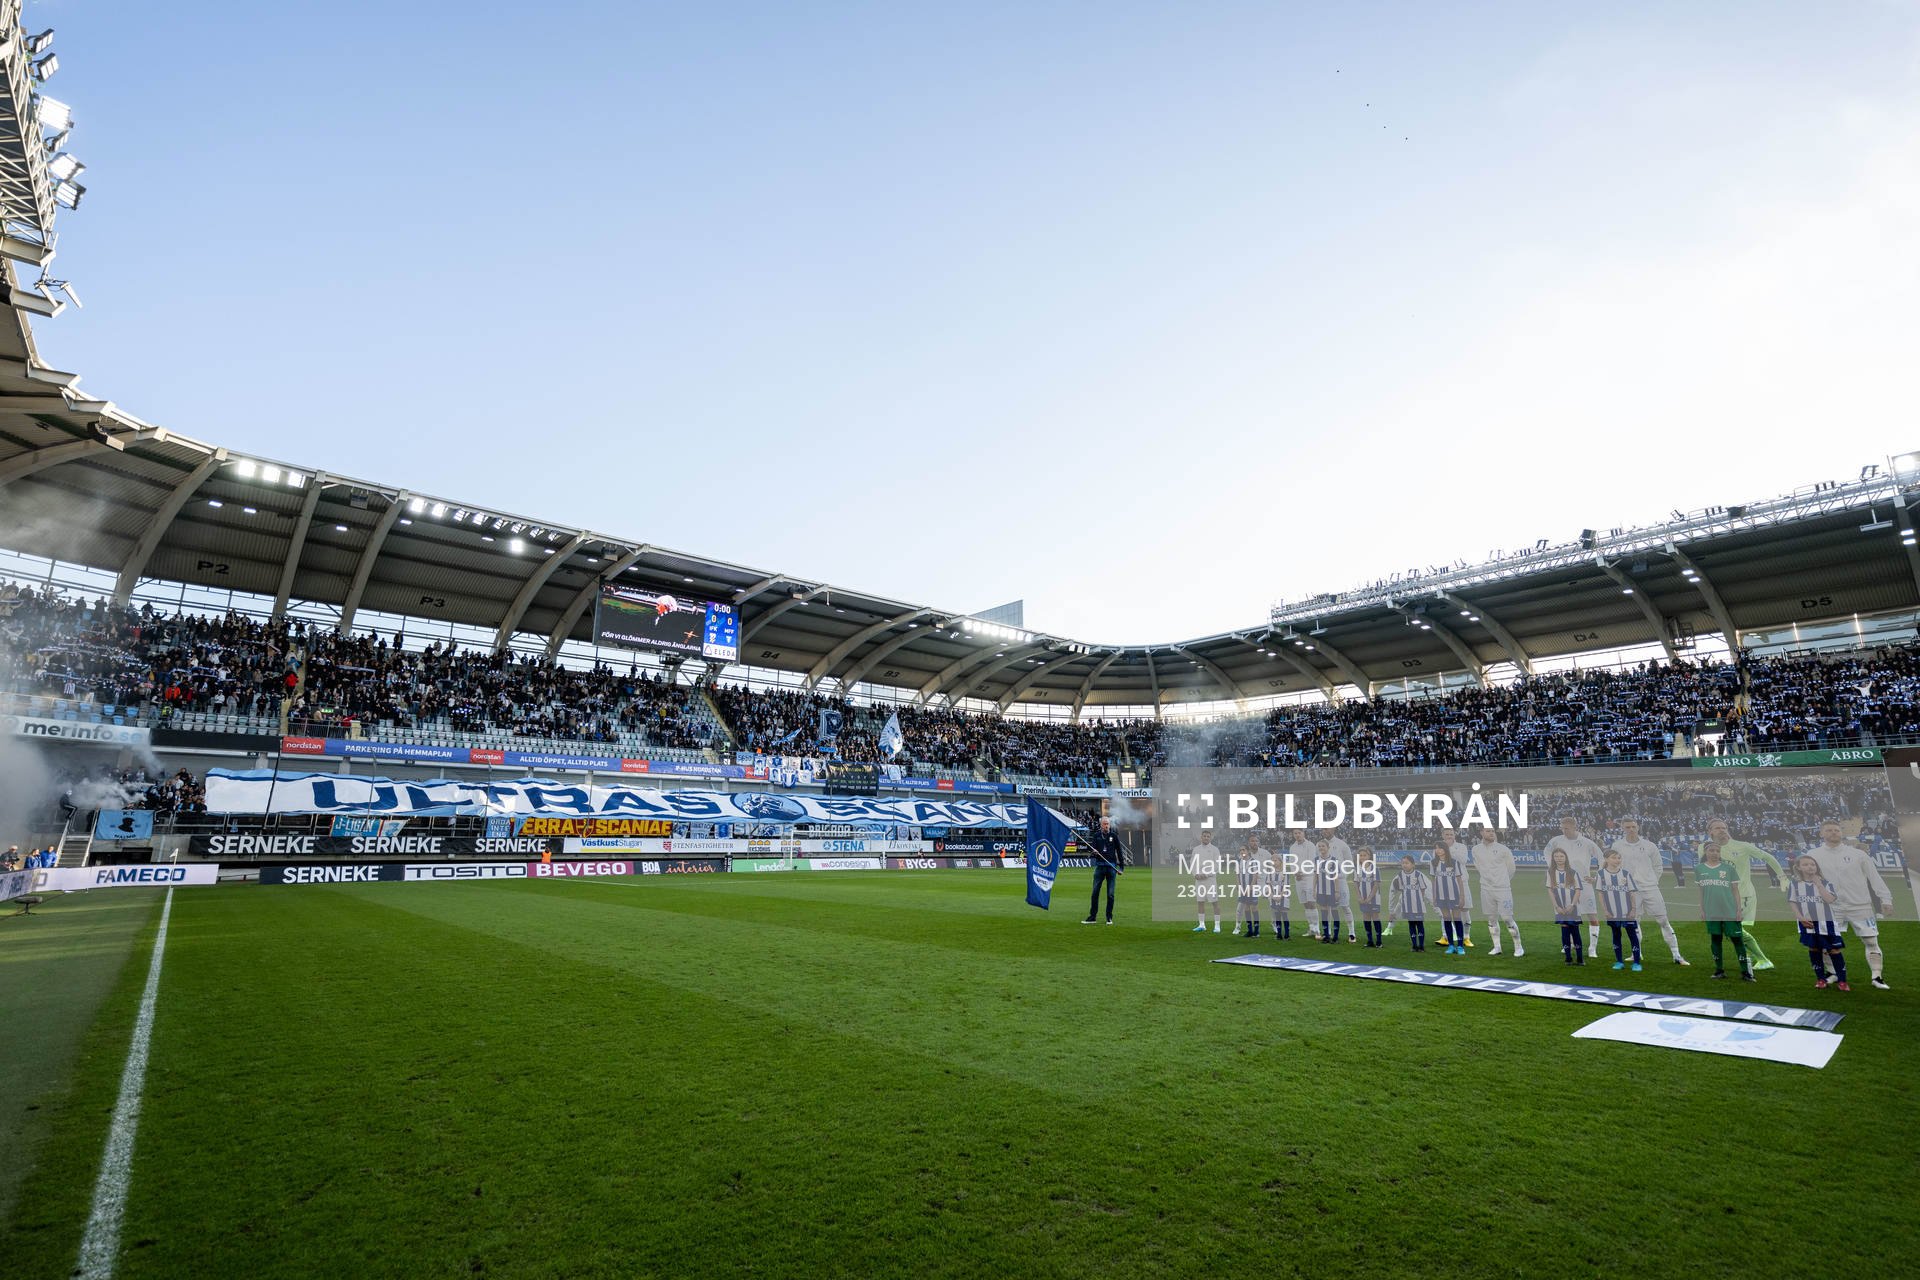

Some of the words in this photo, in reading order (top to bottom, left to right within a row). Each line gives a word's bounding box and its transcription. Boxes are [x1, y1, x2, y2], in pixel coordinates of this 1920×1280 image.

[197, 560, 229, 575] P2
[714, 603, 731, 614] 0:00
[286, 742, 322, 750] nordstan
[345, 744, 392, 754] PARKERING
[404, 749, 453, 758] HEMMAPLAN
[1713, 757, 1751, 767] ÅBRO
[1831, 750, 1874, 761] ÅBRO
[510, 817, 574, 835] ERRA
[595, 819, 672, 836] SCANIAE
[208, 835, 315, 854] SERNEKE
[351, 836, 442, 854] SERNEKE
[475, 838, 546, 853] SERNEKE
[673, 842, 734, 850] STENFASTIGHETER
[833, 840, 864, 851] STENA
[406, 864, 526, 879] TOSITO
[536, 862, 627, 877] BEVEGO
[642, 861, 661, 873] BOA
[96, 868, 186, 884] FAMECO
[282, 866, 379, 884] SERNEKE
[1287, 962, 1806, 1026] ALLSVENSKAN
